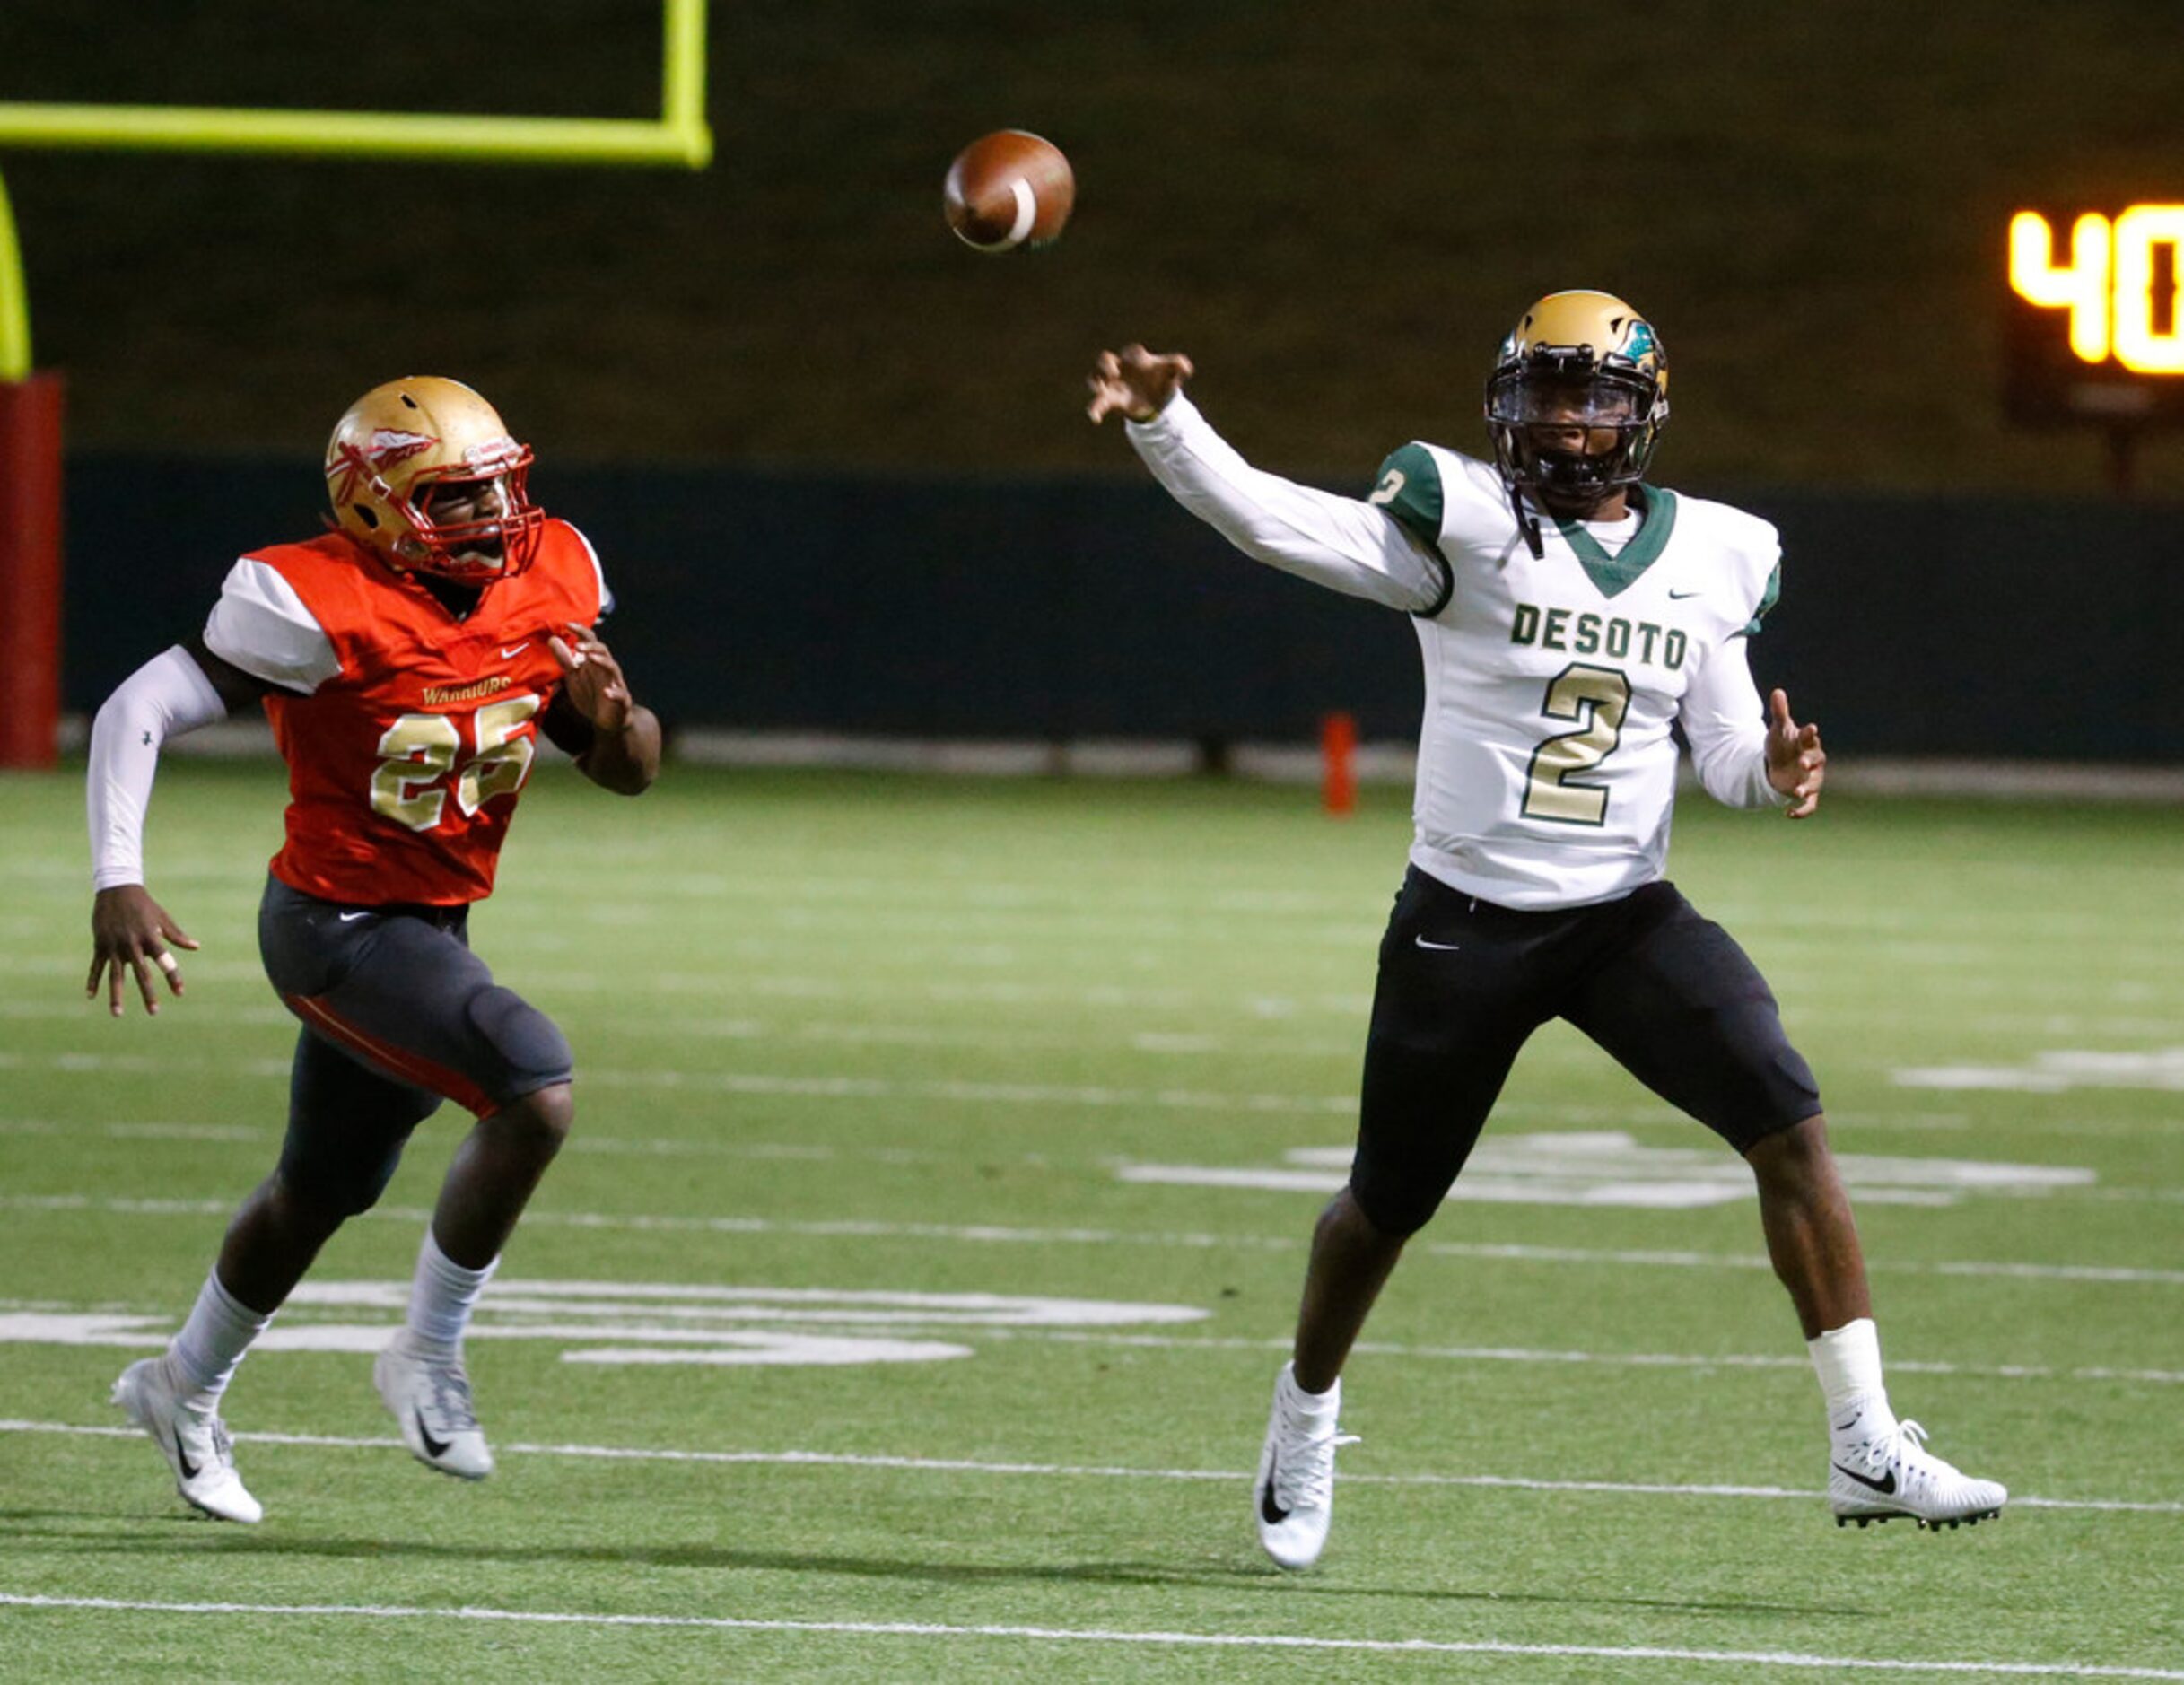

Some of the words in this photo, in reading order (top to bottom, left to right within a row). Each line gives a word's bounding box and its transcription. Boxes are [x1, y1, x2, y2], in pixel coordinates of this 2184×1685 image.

[2008, 203, 2184, 375] 40
[1510, 602, 1688, 671] DESOTO
[1519, 661, 1632, 827] 2
